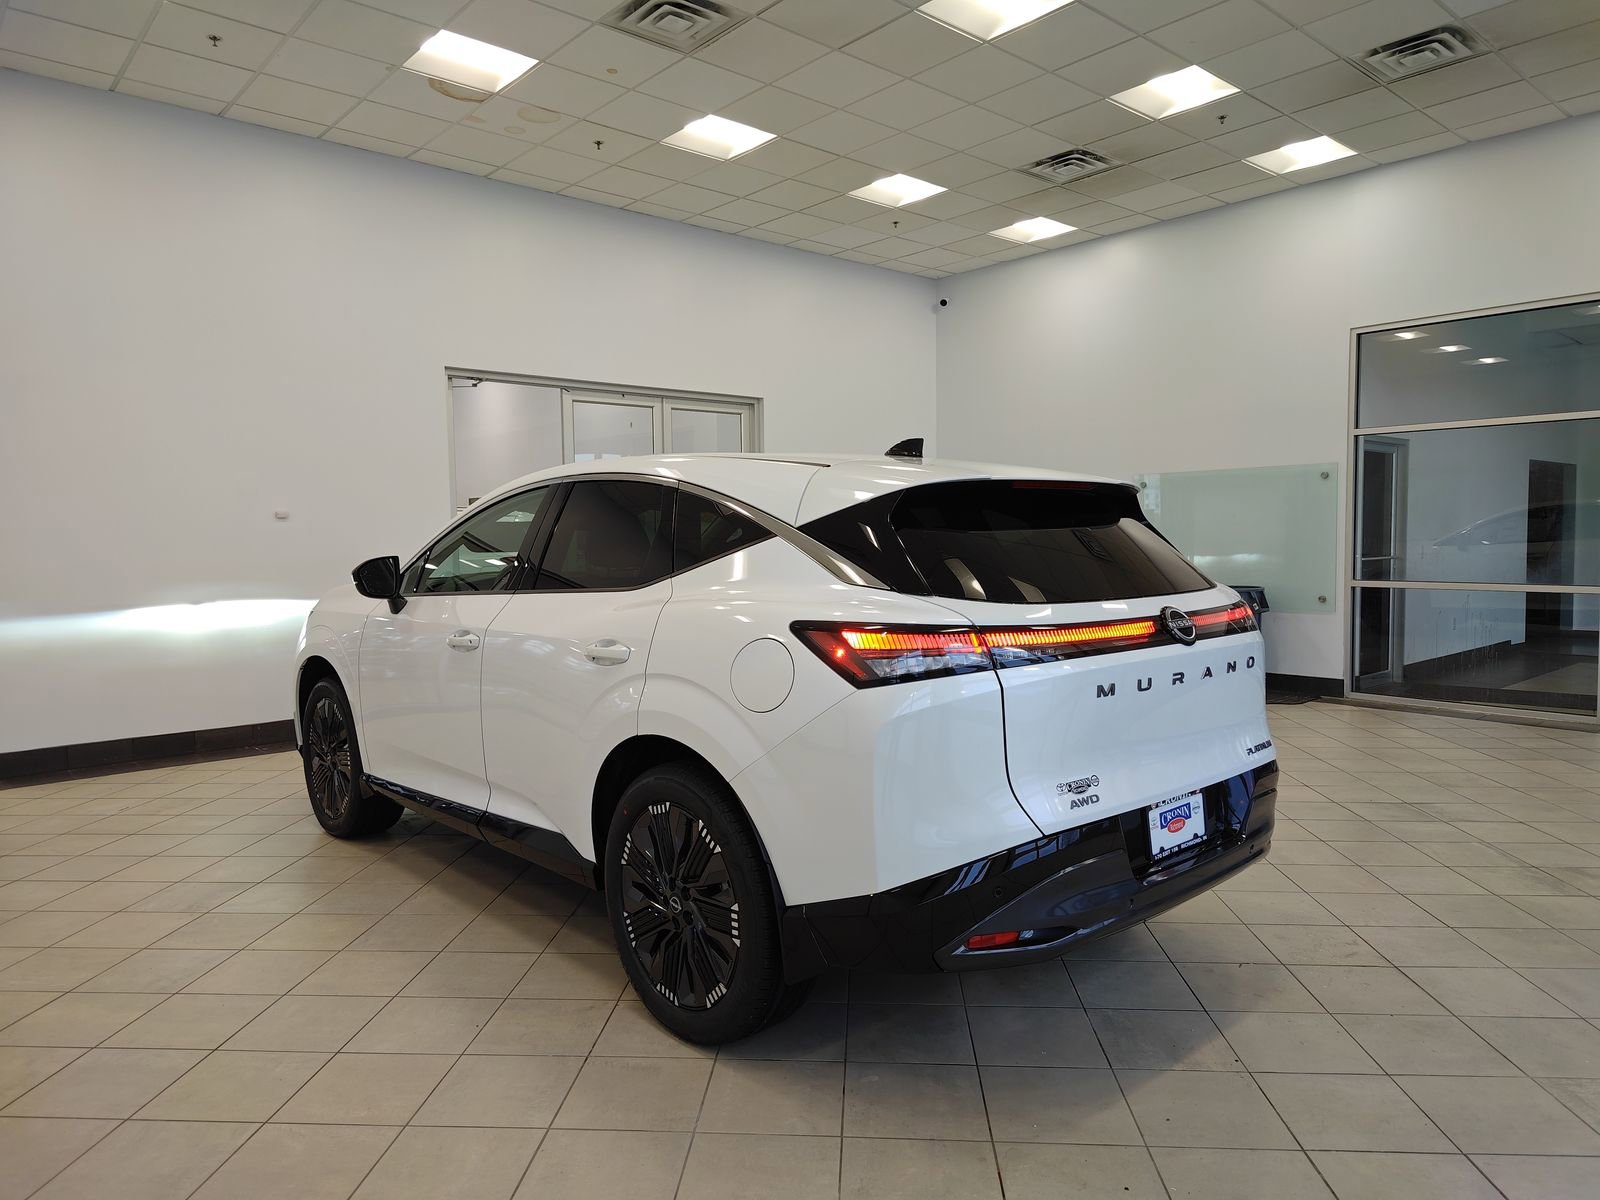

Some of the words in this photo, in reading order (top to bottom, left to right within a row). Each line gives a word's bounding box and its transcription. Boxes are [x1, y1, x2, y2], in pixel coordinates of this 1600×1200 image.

[1096, 655, 1256, 699] MURANO
[1070, 794, 1100, 810] AWD
[1161, 804, 1190, 826] CRONIN
